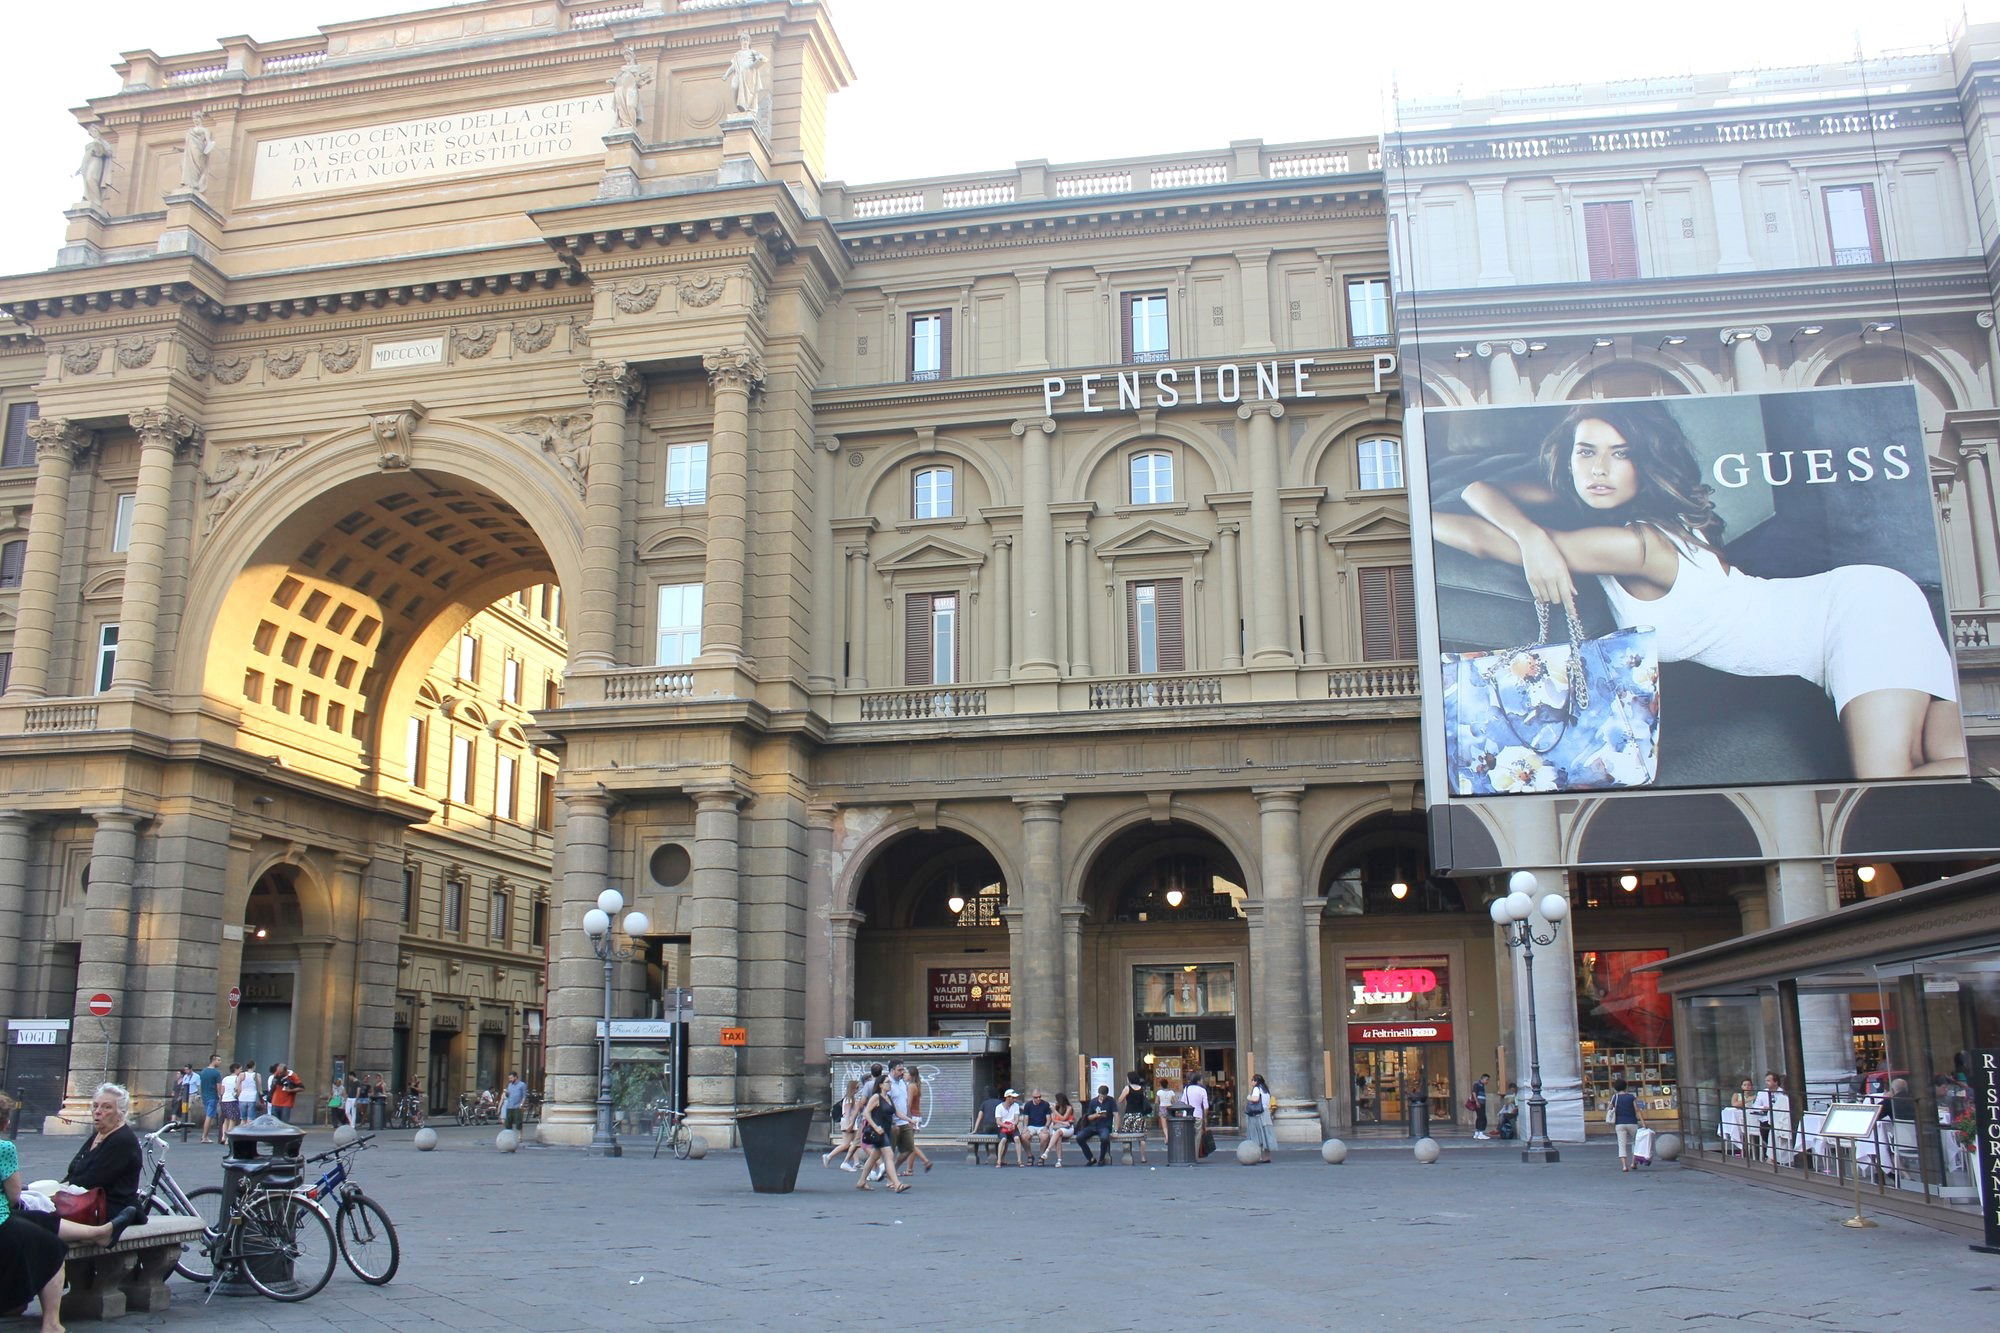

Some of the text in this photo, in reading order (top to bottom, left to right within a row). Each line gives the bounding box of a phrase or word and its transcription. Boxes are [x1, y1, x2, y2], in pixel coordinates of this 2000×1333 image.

[288, 133, 361, 154] ANTICO
[369, 120, 452, 143] CENTRO
[461, 109, 532, 131] DELLA
[293, 120, 573, 171] DA SECOLARE SQUALLORE
[291, 137, 572, 189] A VITA NUOVA RESTITUITO
[375, 344, 438, 362] MDCCCXCV
[1042, 353, 1397, 416] PENSIONE P
[1713, 444, 1911, 488] GUESS
[940, 972, 1009, 985] TABACCH
[933, 994, 968, 1002] BOLLATI
[19, 1031, 56, 1043] VOGUE
[723, 1032, 745, 1041] TAXI
[1372, 1028, 1412, 1038] Feltrinelli
[1155, 1067, 1181, 1078] SCONTI
